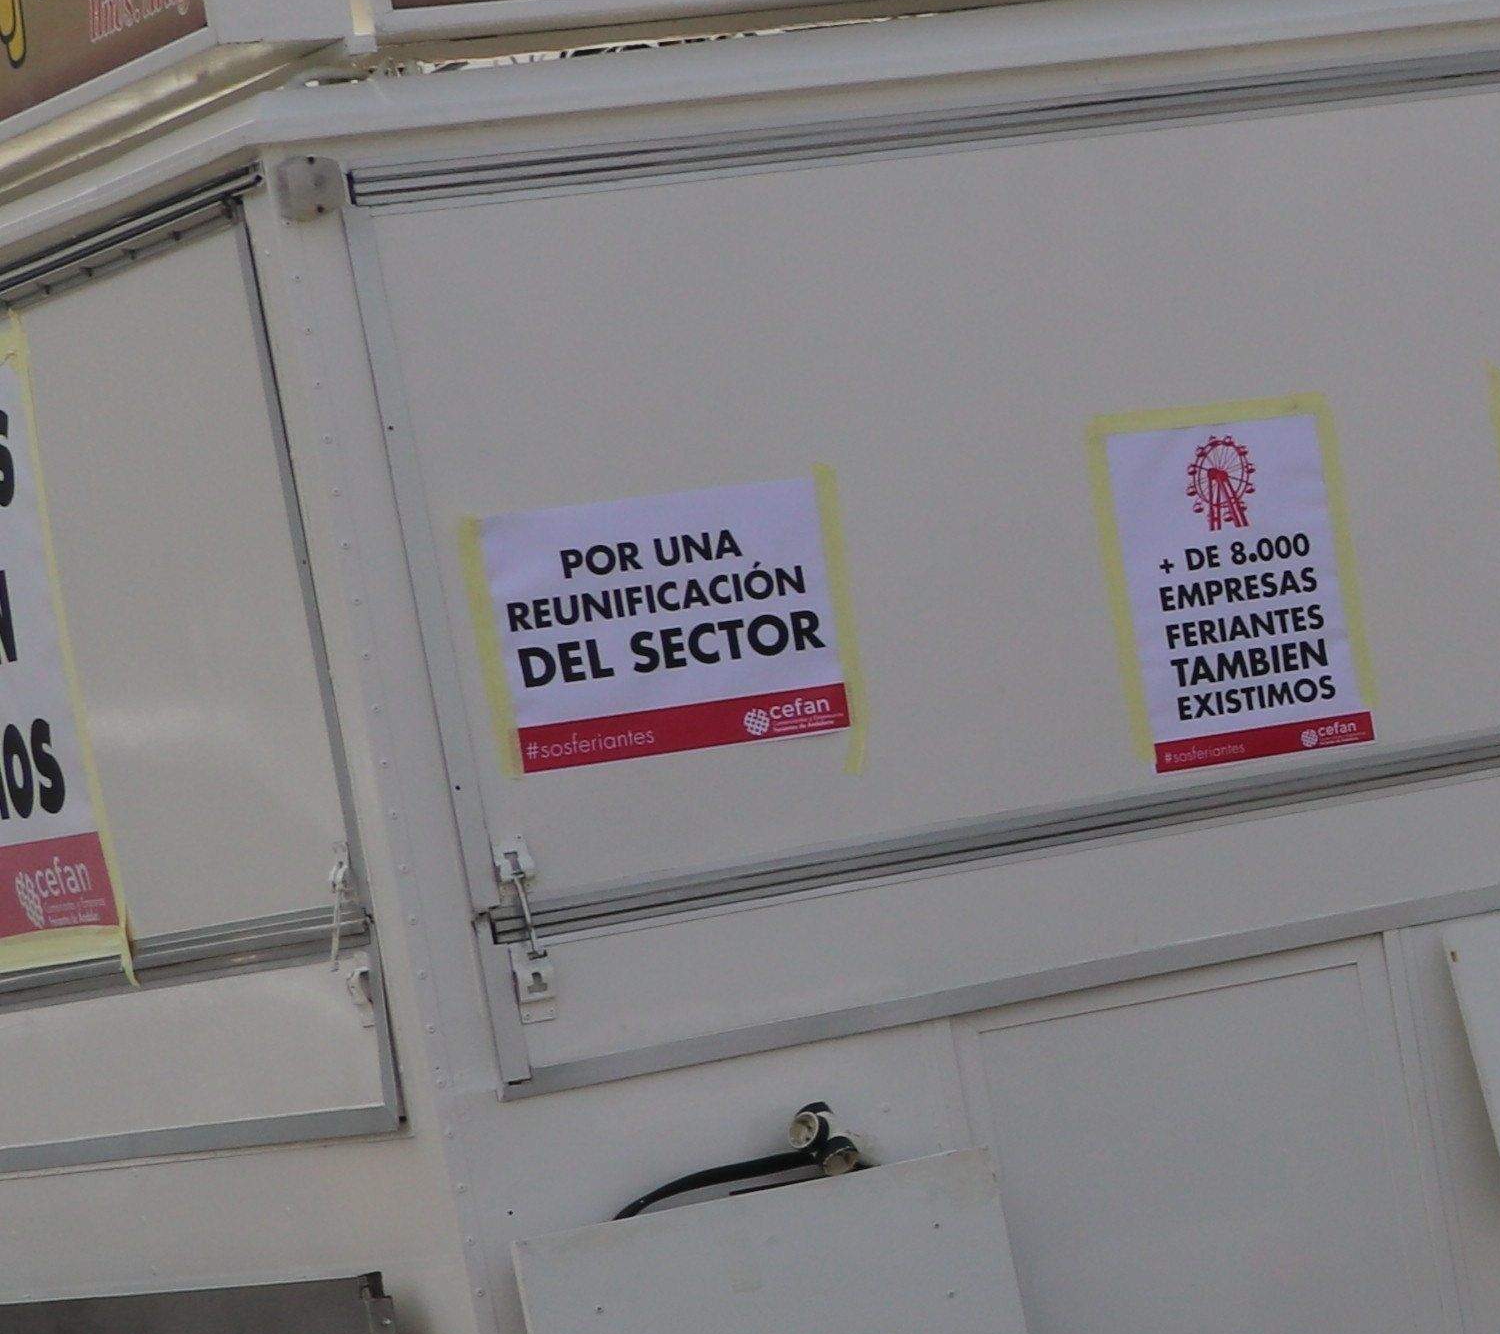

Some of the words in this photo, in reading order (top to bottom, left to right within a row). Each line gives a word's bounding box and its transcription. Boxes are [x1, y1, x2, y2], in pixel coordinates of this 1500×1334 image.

[559, 541, 644, 580] POR
[653, 528, 744, 567] UNA
[1184, 544, 1221, 571] DE
[1230, 532, 1311, 566] 8.000
[506, 561, 807, 633] REUNIFICACIÓN
[1159, 566, 1319, 612] EMPRESAS
[517, 638, 616, 689] DEL
[629, 610, 827, 674] SECTOR
[1165, 604, 1325, 650] FERIANTES
[1170, 638, 1329, 688] TAMBIEN
[1177, 675, 1337, 721] EXISTIMOS
[526, 727, 656, 760] #sosferiantes
[769, 696, 831, 720] cefan
[1317, 719, 1357, 737] cefan
[37, 857, 93, 900] cefan
